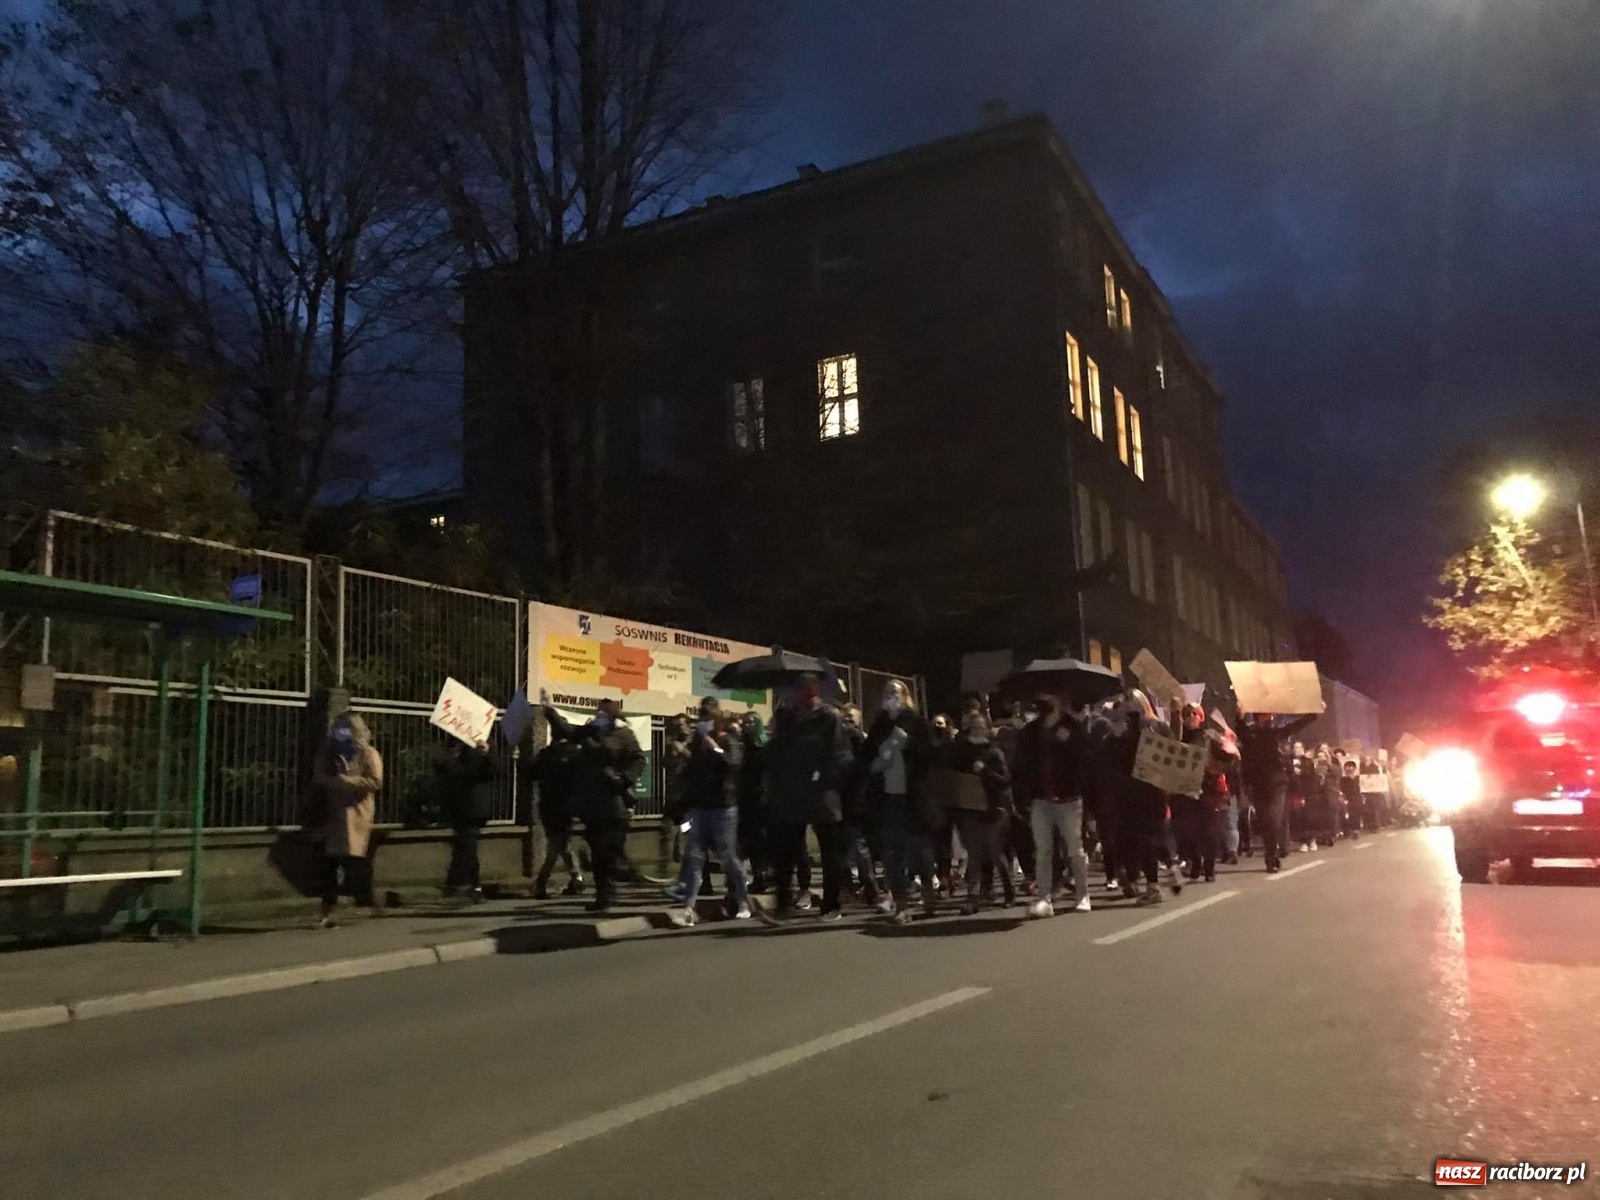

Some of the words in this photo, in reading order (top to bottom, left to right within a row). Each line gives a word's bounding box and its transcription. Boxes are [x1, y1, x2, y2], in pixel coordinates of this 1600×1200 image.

[614, 624, 668, 643] SOSWNIS
[674, 632, 730, 654] REKRUTACJA
[559, 644, 587, 655] Wczesne
[551, 653, 596, 665] wspomaganie
[560, 664, 586, 674] rozwoju
